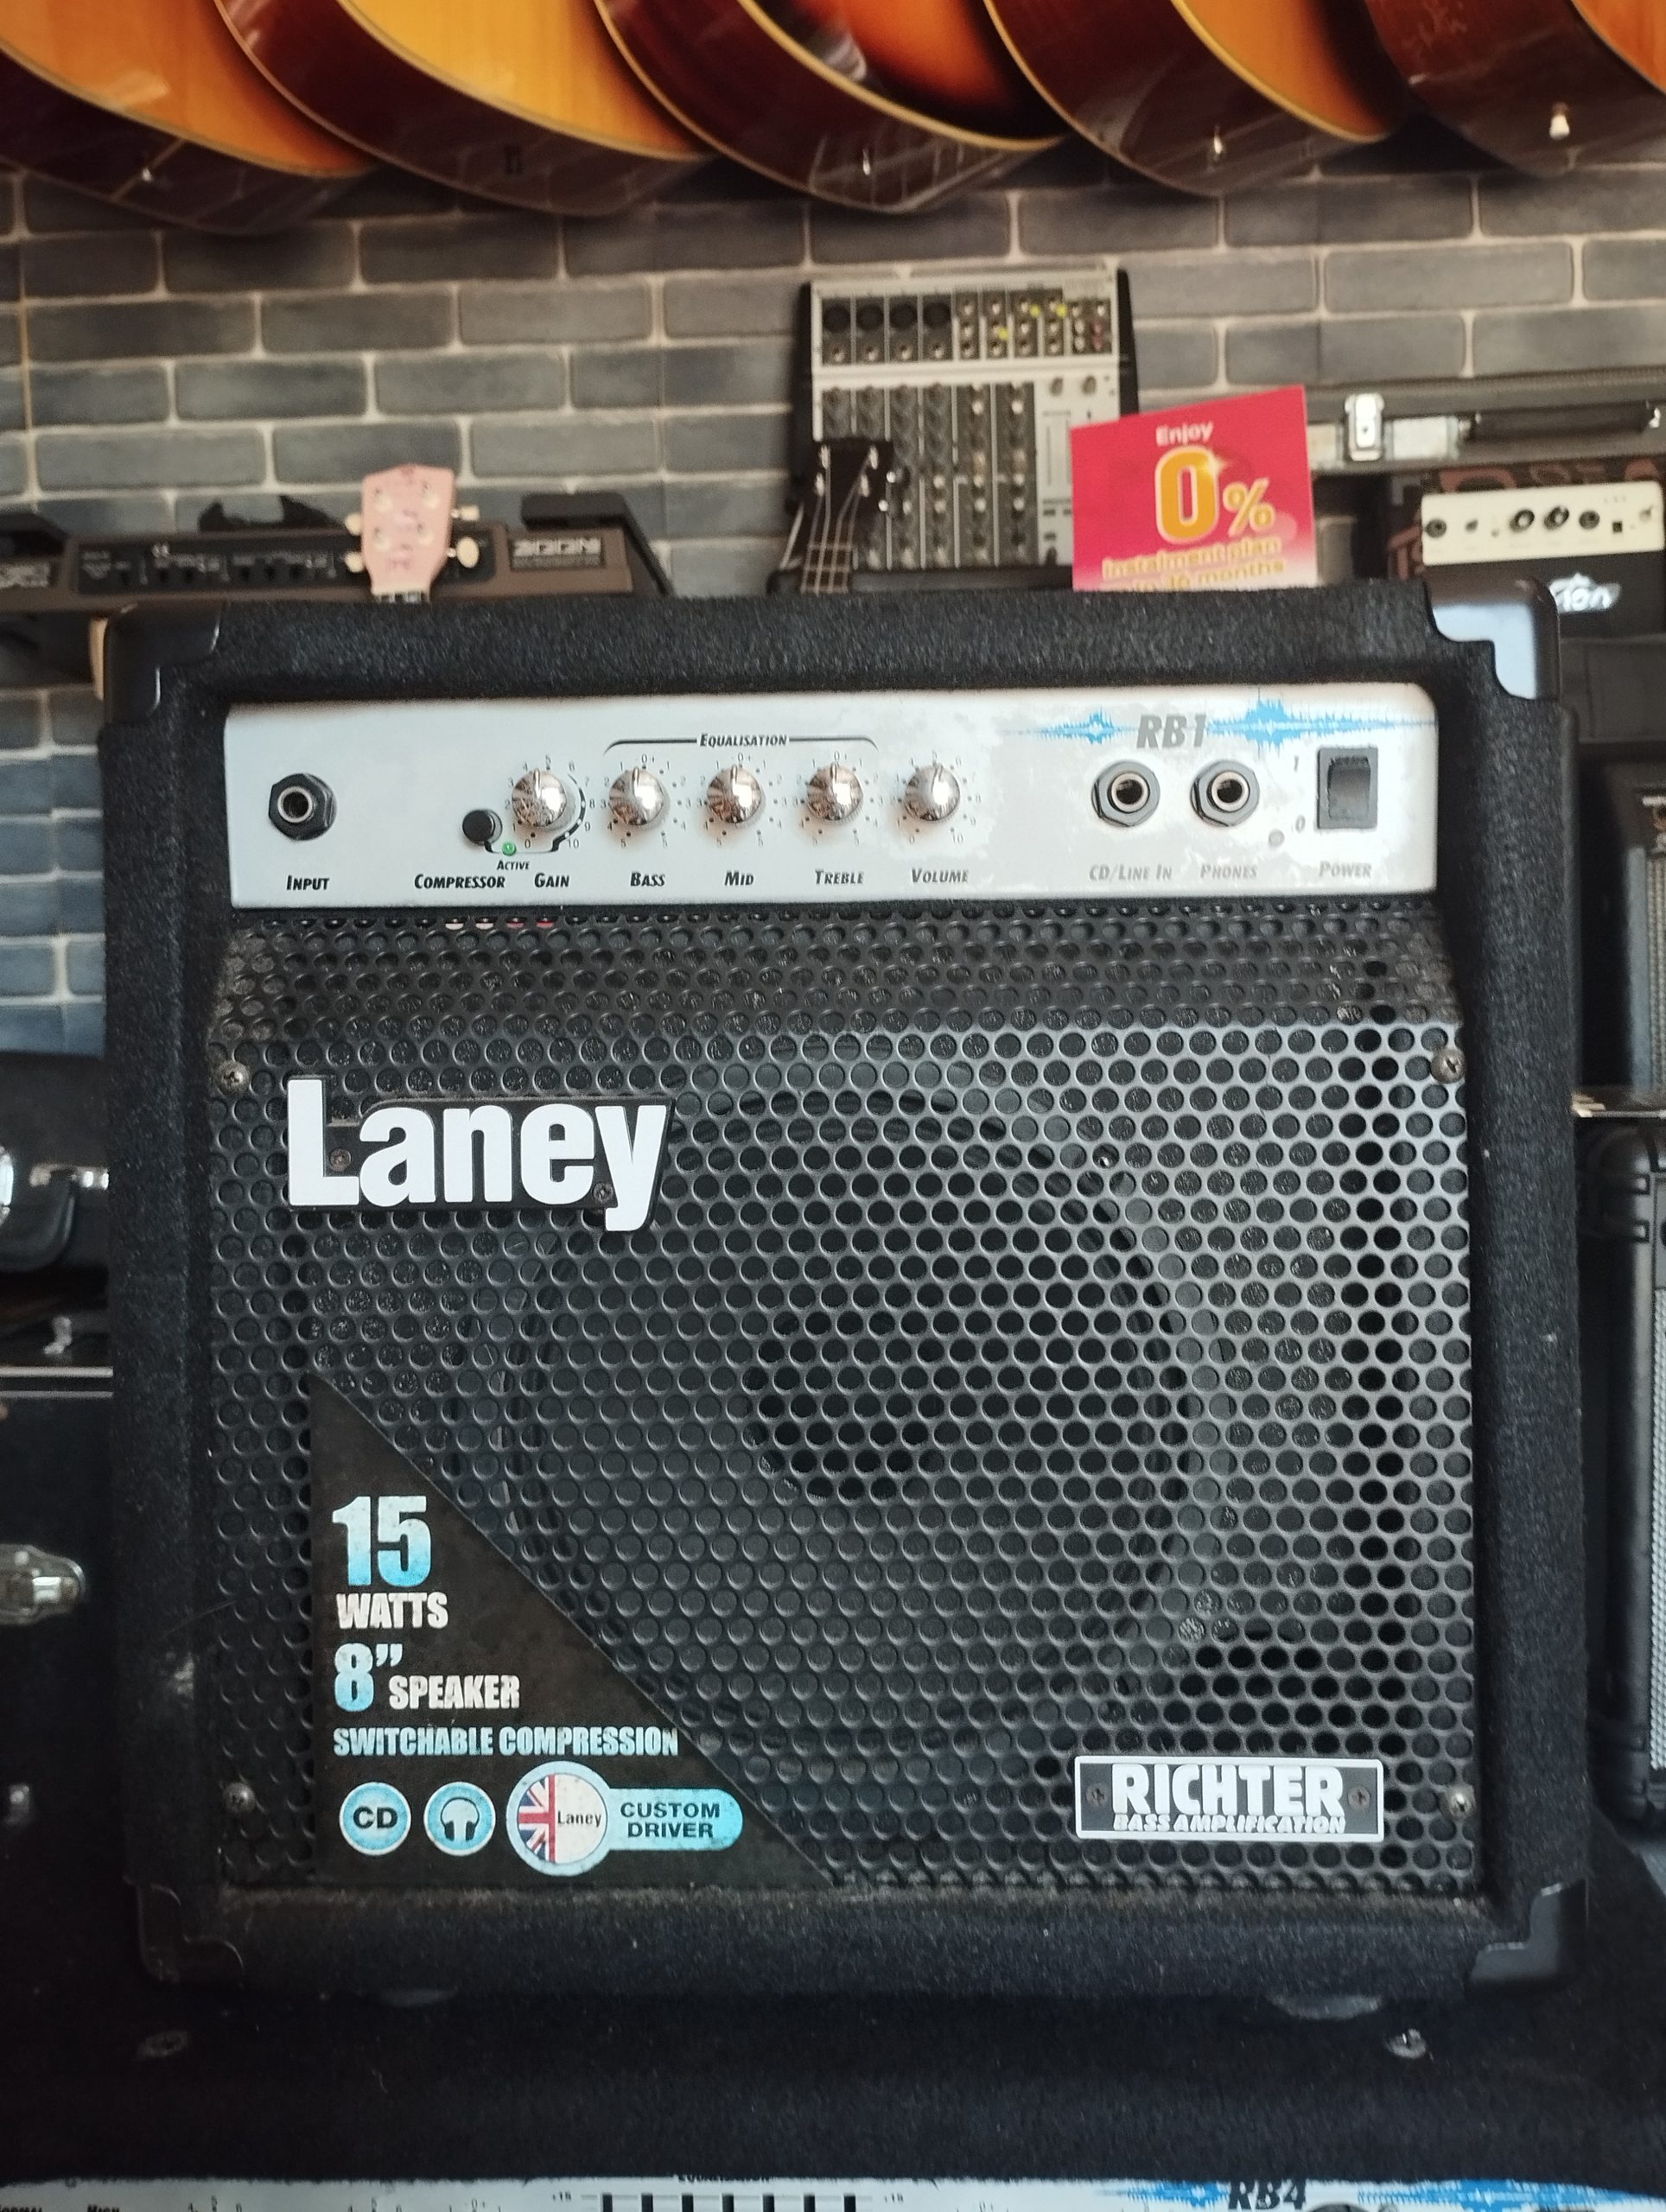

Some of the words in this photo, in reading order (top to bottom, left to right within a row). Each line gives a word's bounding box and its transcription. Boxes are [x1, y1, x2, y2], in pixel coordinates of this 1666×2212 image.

[1155, 421, 1214, 448] Enjoy
[1103, 543, 1225, 581] Instalment
[1227, 535, 1282, 562] plan
[1198, 560, 1286, 584] months
[1136, 713, 1206, 748] RB1
[288, 1079, 667, 1231] Laney
[333, 1495, 431, 1587] 15
[336, 1592, 448, 1629] WATTS
[388, 1675, 520, 1710] SPEAKER
[334, 1726, 493, 1756] SWITCHABLE
[499, 1726, 678, 1756] COMPRESSION
[1111, 1764, 1345, 1816] RICHTER
[353, 1806, 398, 1829] CD
[557, 1811, 601, 1827] Laney
[620, 1802, 720, 1817] CUSTOM
[1113, 1813, 1170, 1832] BASS
[1173, 1815, 1346, 1834] AMPLIFICATION
[628, 1822, 714, 1838] DRIVER
[1229, 2179, 1306, 2209] RB4
